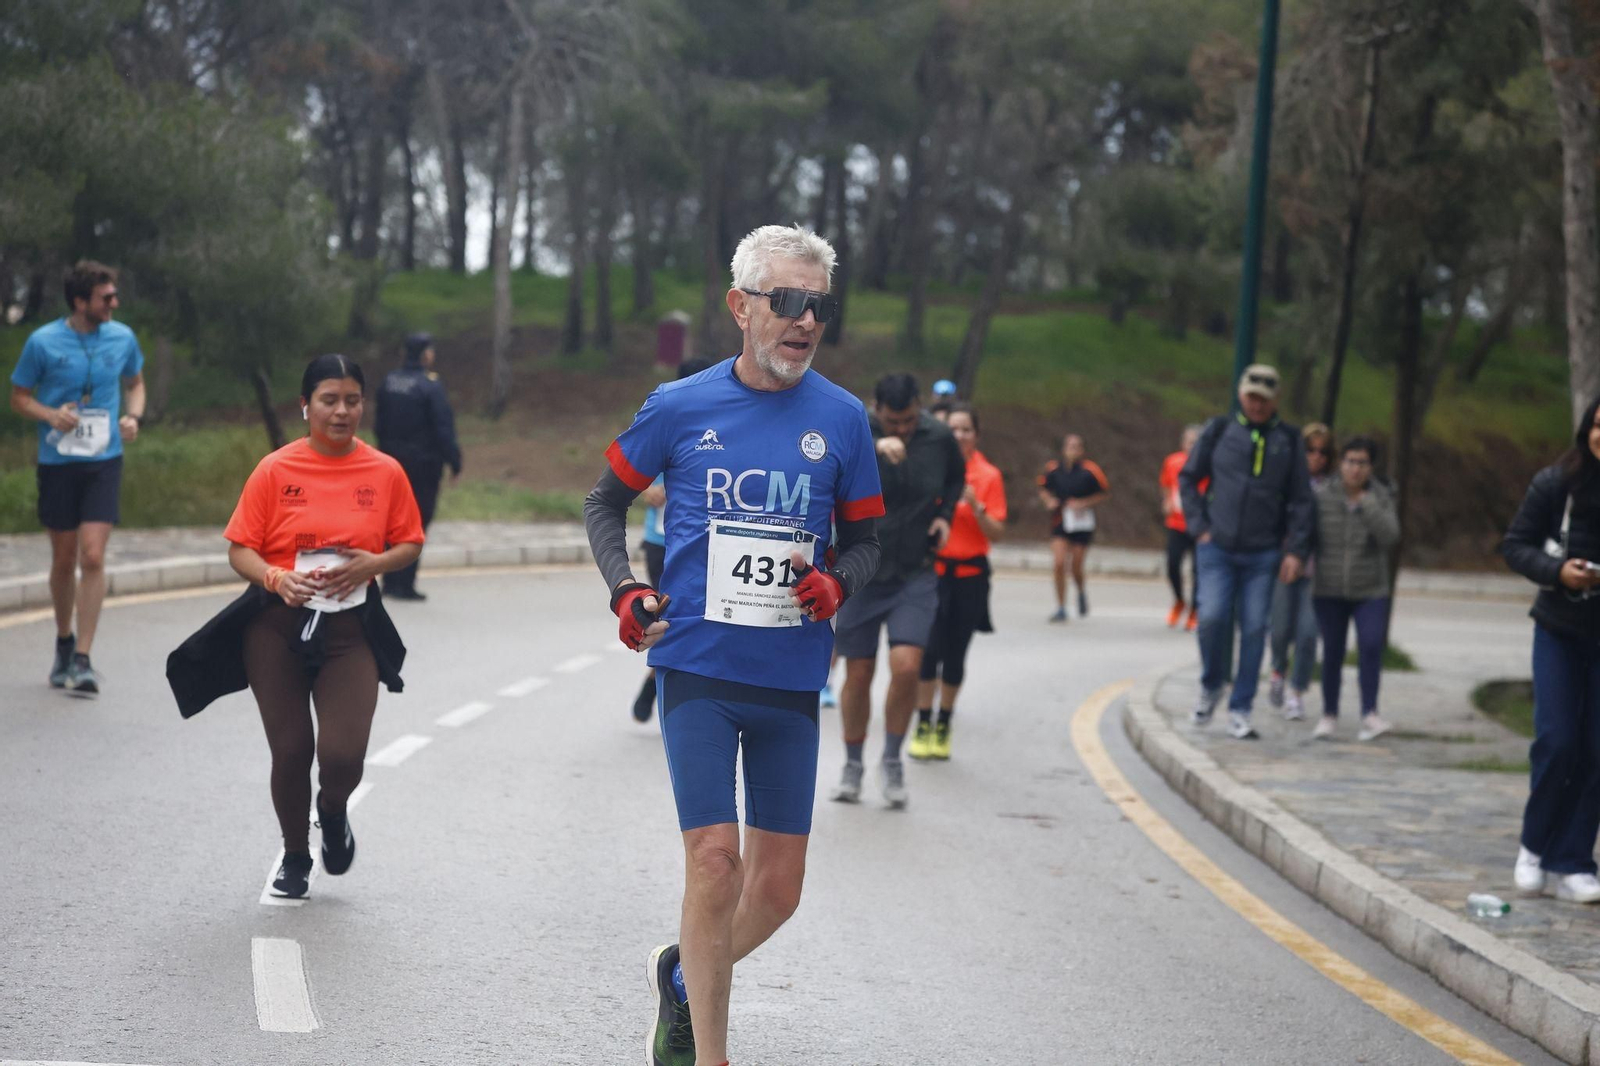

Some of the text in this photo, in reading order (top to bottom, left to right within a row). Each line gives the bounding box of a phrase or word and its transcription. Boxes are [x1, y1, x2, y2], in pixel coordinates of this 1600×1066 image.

[804, 440, 823, 452] RCM
[706, 468, 811, 515] RCM
[731, 554, 792, 587] 431
